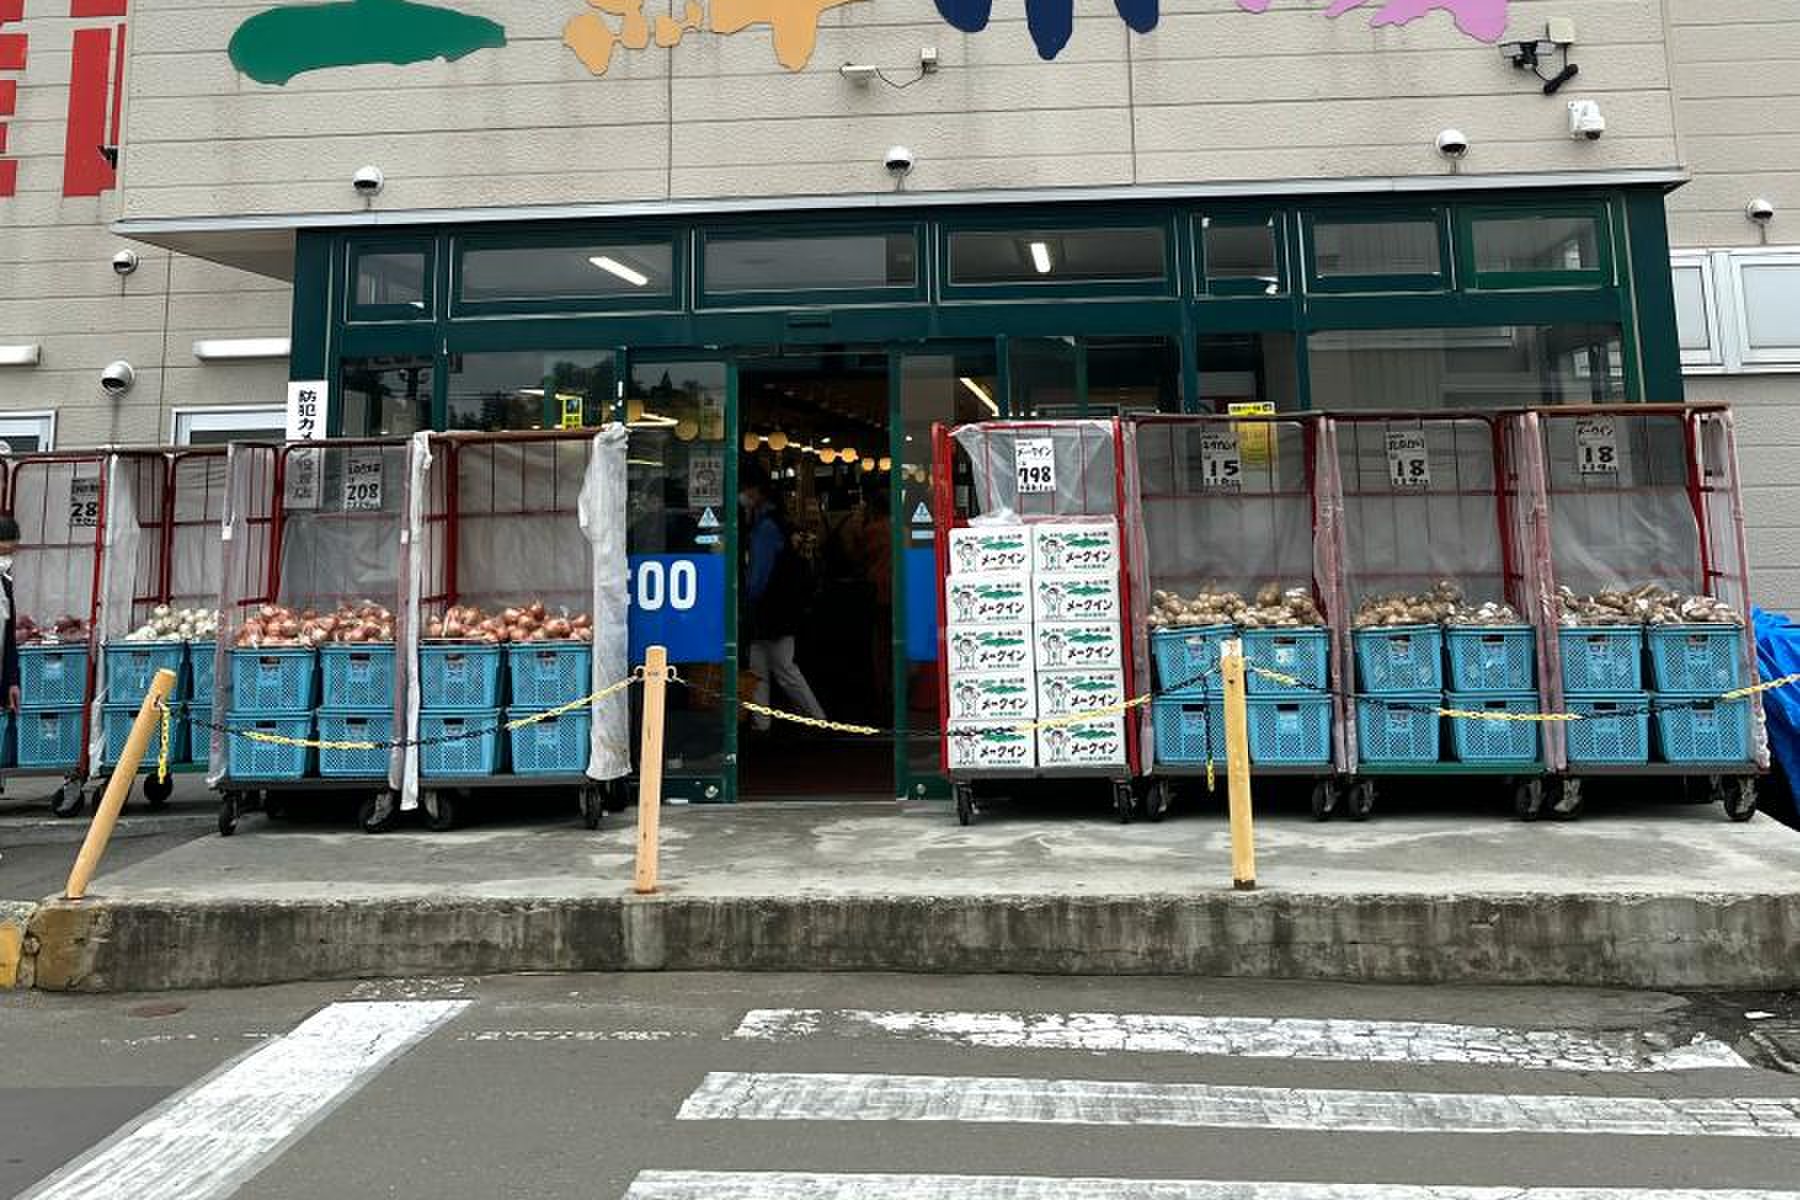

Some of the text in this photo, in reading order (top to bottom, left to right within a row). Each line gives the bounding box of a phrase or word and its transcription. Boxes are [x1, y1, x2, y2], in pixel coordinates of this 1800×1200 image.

[1586, 446, 1615, 463] 18
[1018, 465, 1052, 483] 798
[1210, 460, 1239, 476] 15
[1397, 459, 1427, 477] 18
[347, 483, 379, 500] 208
[982, 553, 1026, 566] メークイン
[1066, 550, 1112, 563] メークイン
[979, 601, 1025, 614] メークイン
[1067, 598, 1113, 611] メークイン
[980, 649, 1027, 663] メークイン
[1068, 646, 1115, 659] メークイン
[982, 697, 1029, 710] メークイン
[1071, 693, 1118, 707] メークイン
[980, 744, 1027, 758] メークイン
[1072, 742, 1119, 755] メークイン
